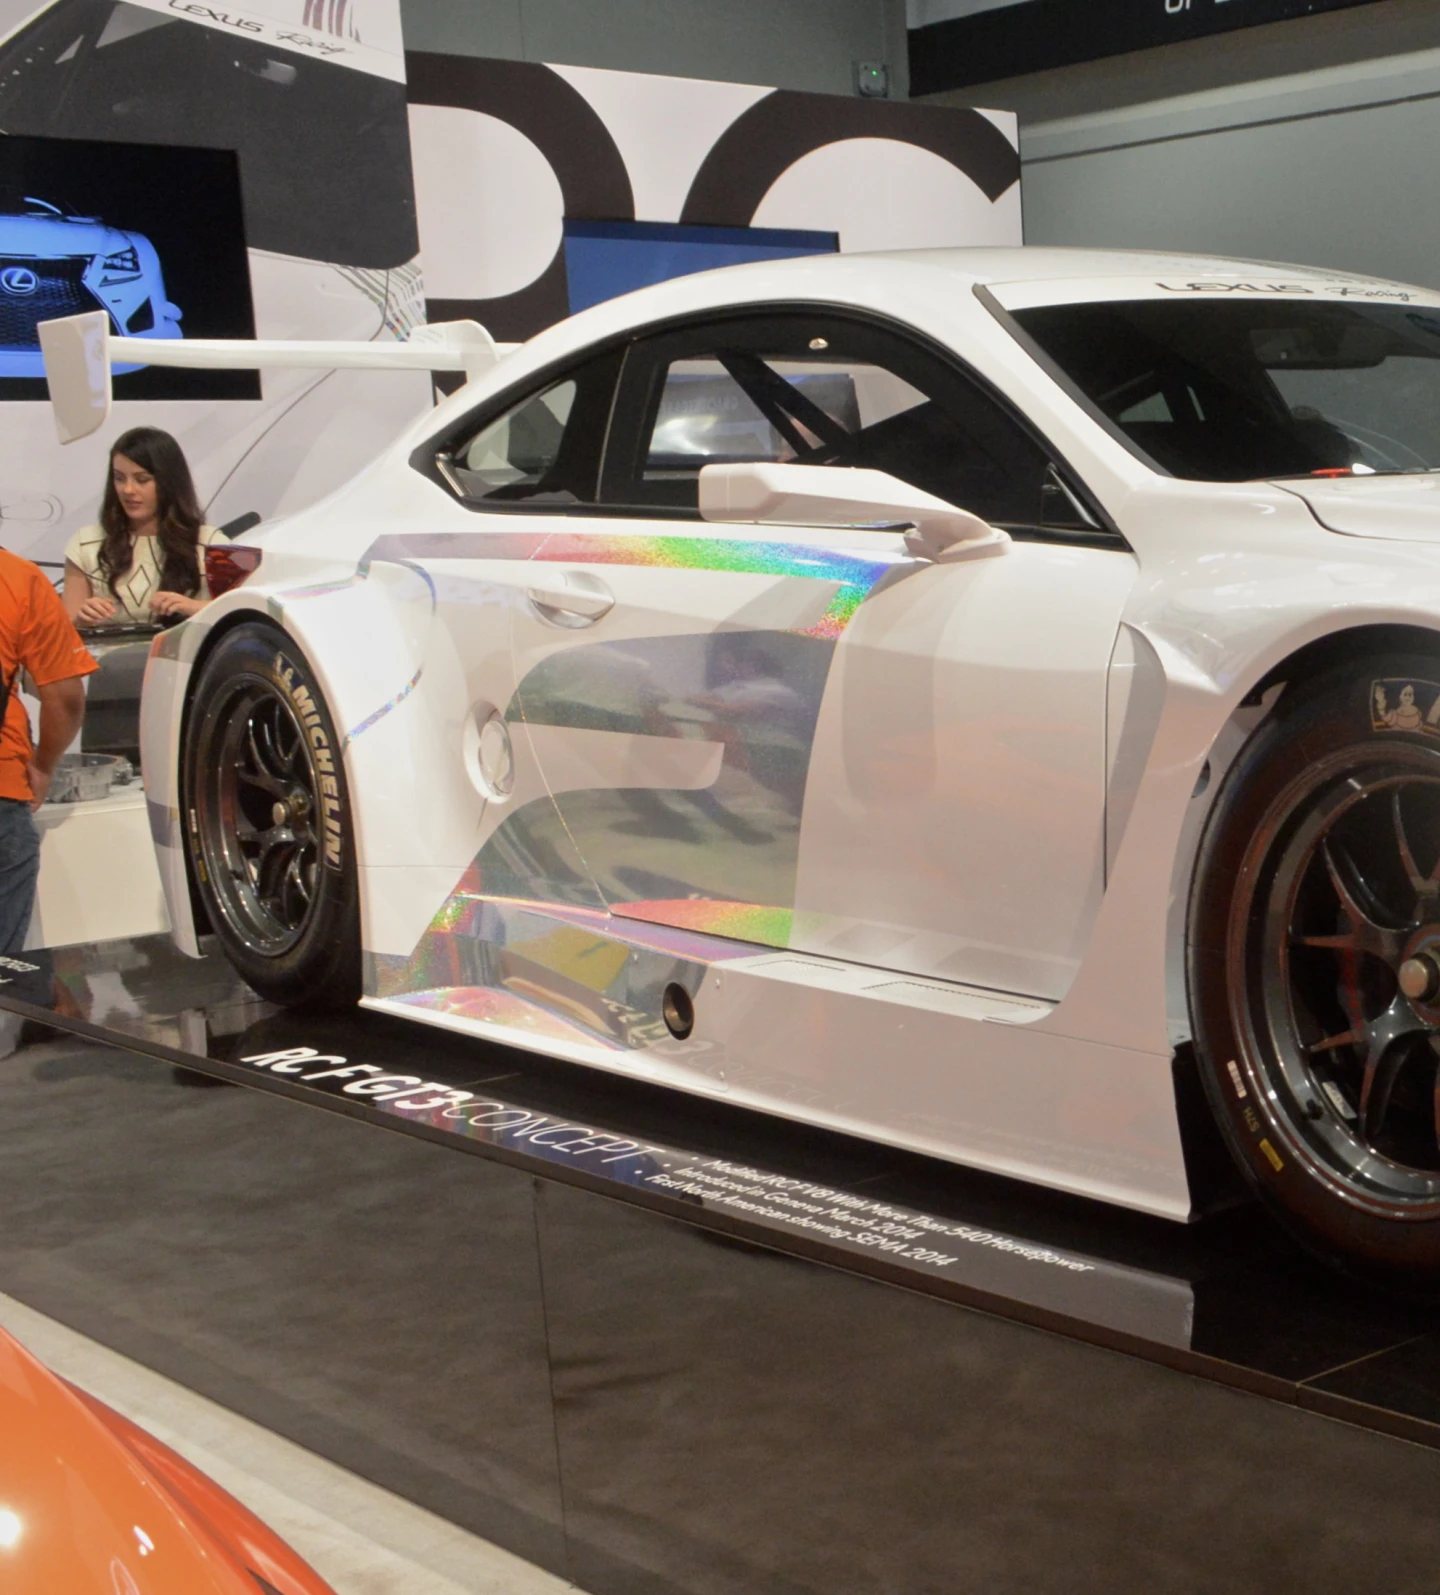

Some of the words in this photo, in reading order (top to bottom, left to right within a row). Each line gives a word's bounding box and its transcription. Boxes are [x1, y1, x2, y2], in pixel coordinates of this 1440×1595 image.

[169, 0, 264, 32] LEXUS
[1154, 282, 1314, 295] LEXUS
[1324, 286, 1418, 302] Racing
[291, 684, 342, 870] MICHELIN
[239, 1046, 348, 1074] RC
[300, 1063, 384, 1081] F
[342, 1075, 475, 1110] GT3
[442, 1102, 666, 1164] CONCEPT
[644, 1173, 685, 1190] First
[674, 1182, 726, 1201] North
[716, 1195, 792, 1221] American
[785, 1216, 852, 1239] showing
[846, 1231, 909, 1254] SEMA
[900, 1247, 959, 1267] 2014
[673, 1166, 756, 1196] Introduced
[763, 1191, 824, 1215] Geneva
[819, 1207, 879, 1228] March
[869, 1222, 926, 1240] 2014
[702, 1159, 769, 1182] Modified
[764, 1174, 801, 1190] RC
[802, 1186, 835, 1199] V8
[825, 1193, 868, 1209] With
[860, 1203, 908, 1221] More
[906, 1215, 947, 1232] Than
[945, 1226, 992, 1243] 540
[981, 1236, 1096, 1272] Horsepower
